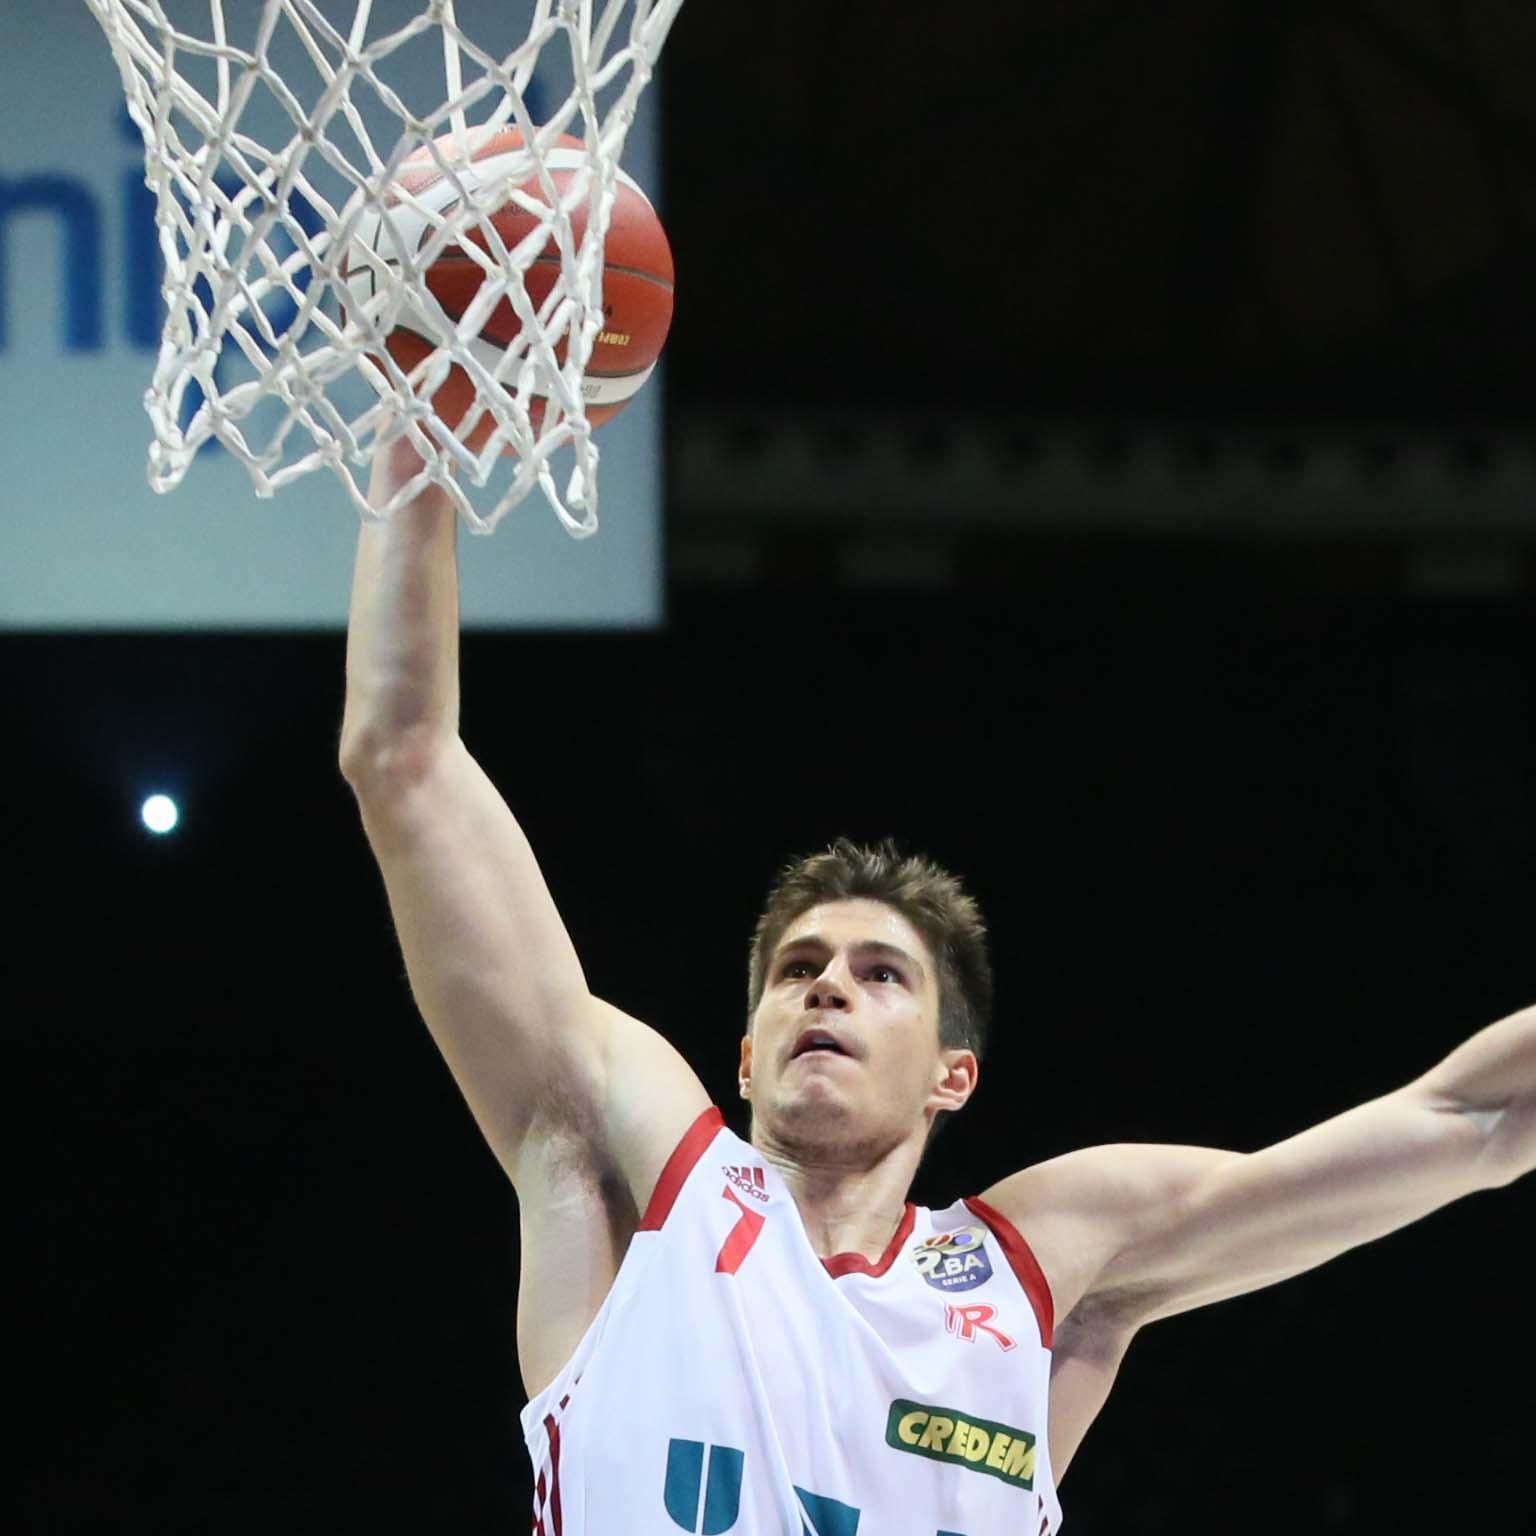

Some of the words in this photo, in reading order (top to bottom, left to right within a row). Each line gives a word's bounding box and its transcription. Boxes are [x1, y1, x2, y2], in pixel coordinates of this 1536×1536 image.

[721, 1165, 770, 1202] adidas
[714, 1184, 766, 1277] 7
[897, 1410, 1037, 1481] CREDEM
